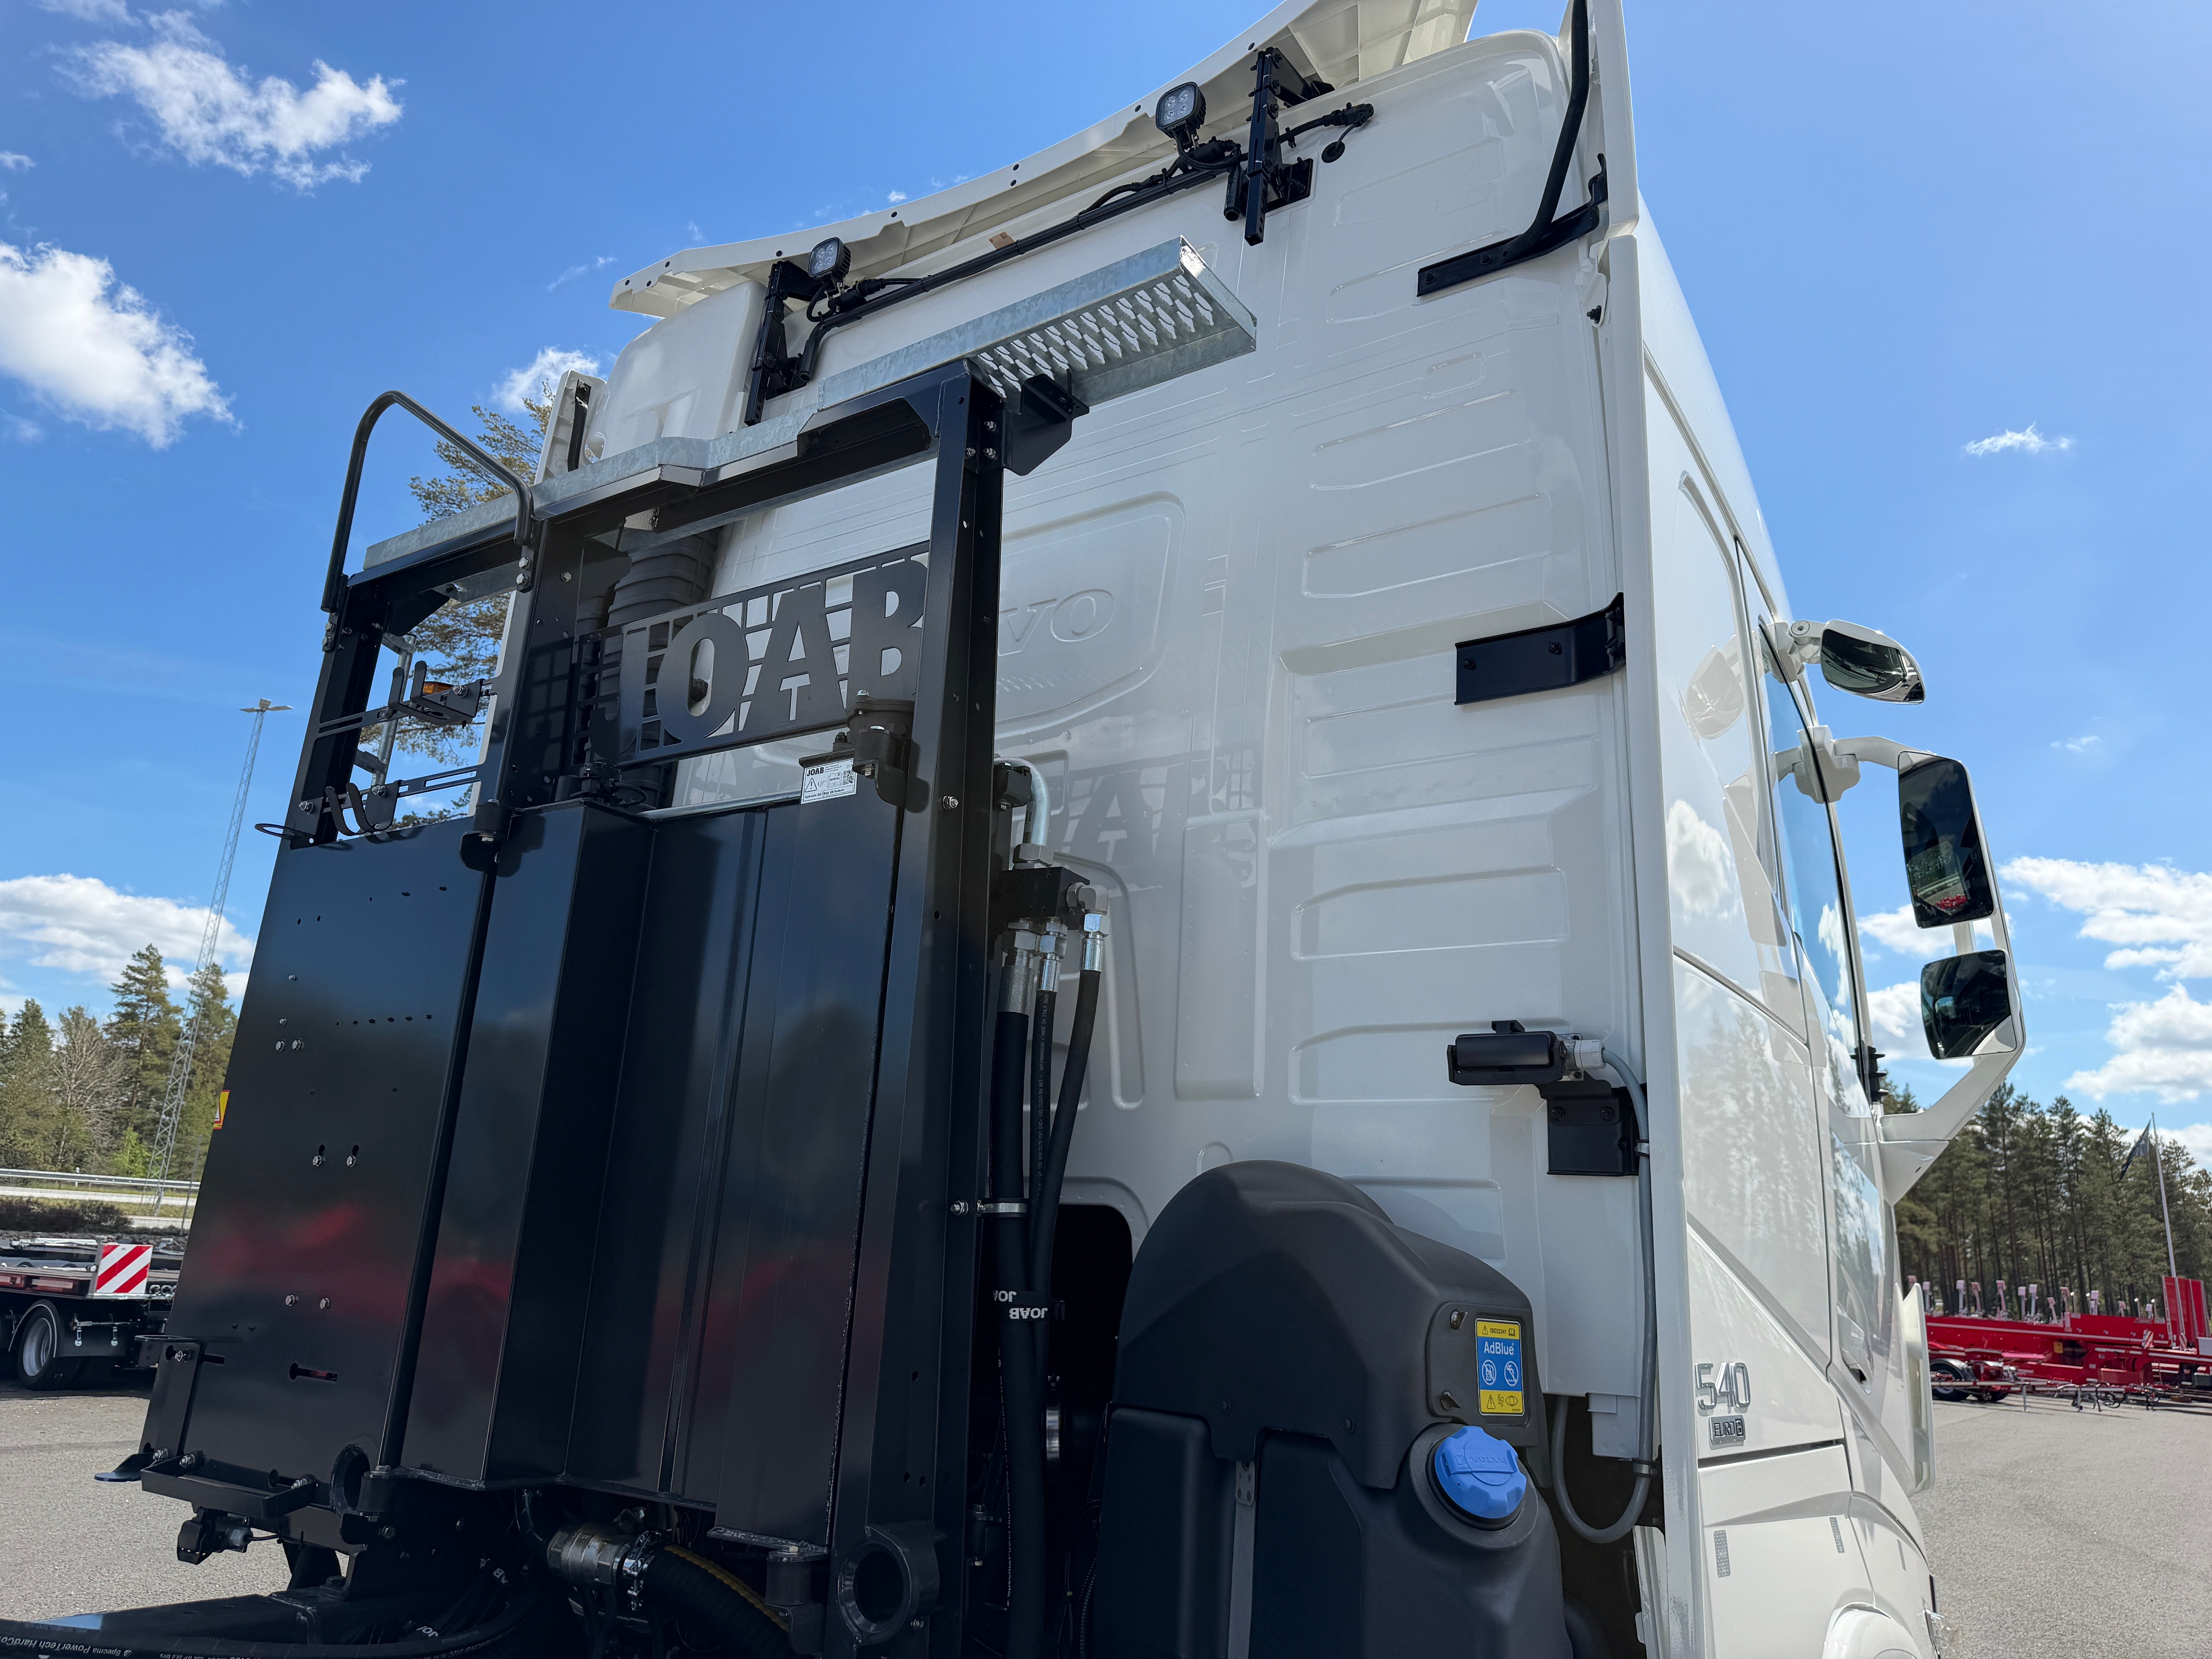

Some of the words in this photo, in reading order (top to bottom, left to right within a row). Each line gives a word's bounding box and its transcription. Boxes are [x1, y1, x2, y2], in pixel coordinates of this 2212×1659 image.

[589, 560, 928, 758] JOAB
[807, 767, 824, 776] JOAB
[1009, 1307, 1048, 1319] JOAB
[1484, 1341, 1514, 1355] AdBlue
[1694, 1362, 1751, 1410] 540
[0, 1636, 38, 1648] HardCo
[39, 1640, 91, 1654] PowerTech
